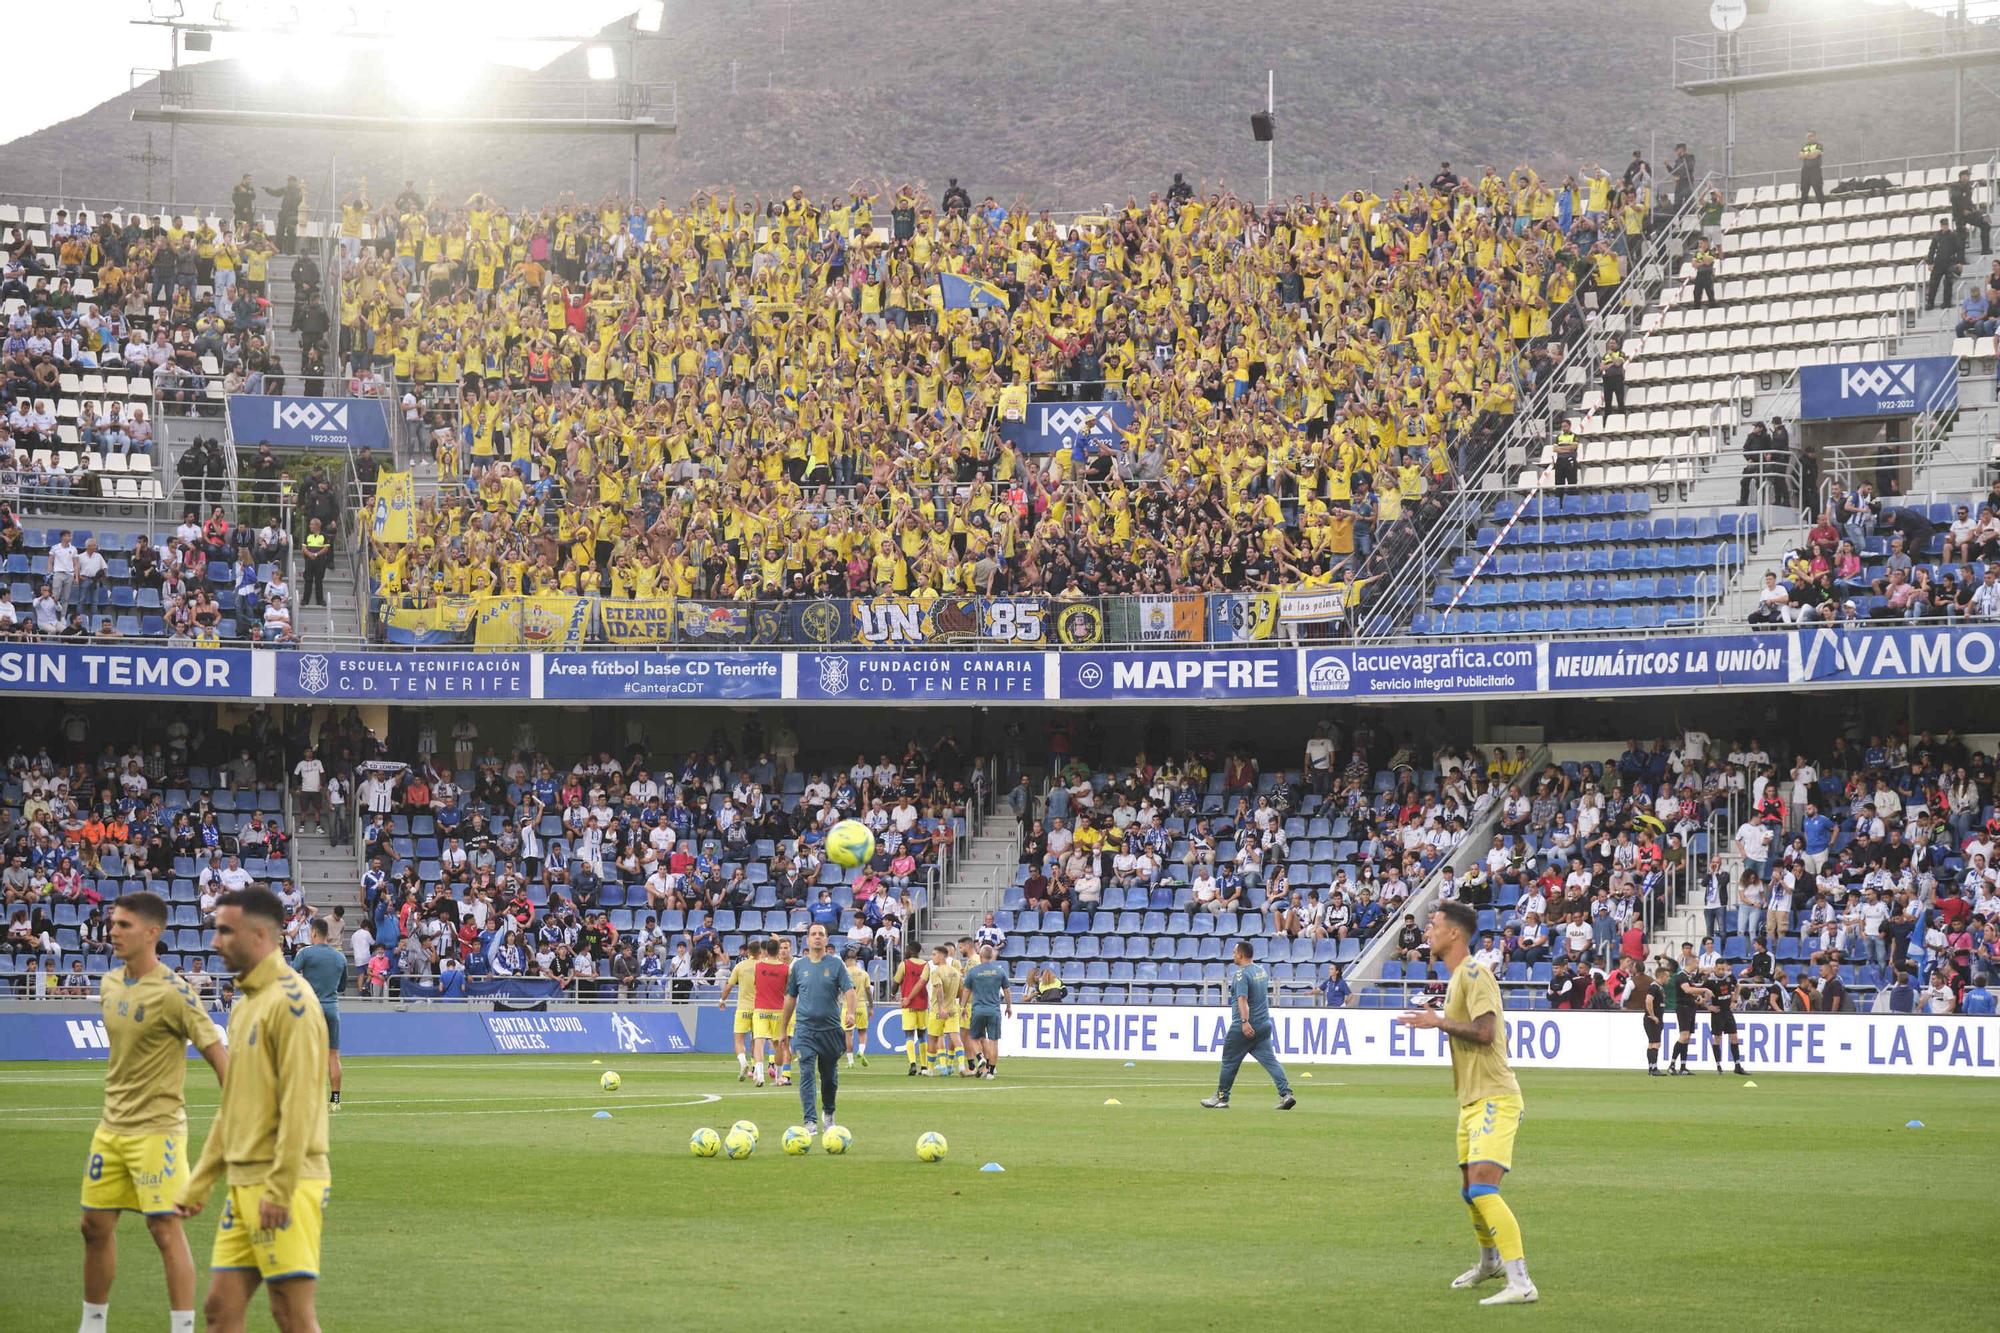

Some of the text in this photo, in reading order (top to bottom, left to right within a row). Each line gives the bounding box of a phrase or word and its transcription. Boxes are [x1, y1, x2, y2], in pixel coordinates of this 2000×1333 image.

[1878, 400, 1915, 410] 1922-2022
[310, 434, 347, 443] 1922-2022
[605, 607, 667, 621] ETERNO
[857, 604, 922, 641] UN
[992, 603, 1041, 641] 85
[1232, 601, 1257, 630] 85
[1164, 630, 1193, 640] ARMY
[1352, 647, 1532, 675] lacuevagrafica.com
[1555, 643, 1782, 677] NEUMÁTICOS LA UNIÓN
[1843, 631, 2000, 676] VAMO
[0, 652, 230, 688] SIN TEMOR
[340, 658, 520, 672] ESCUELA TECNIFICACIÓN
[549, 658, 777, 677] Área fútbol base CD Tenerife
[860, 658, 1032, 672] FUNDACIÓN CANARIA
[1113, 659, 1278, 689] MAPFRE
[1314, 668, 1345, 681] LCG
[1370, 674, 1515, 691] Servicio Integral Publicitario
[340, 677, 520, 691] C. D. TENERIFE
[623, 682, 705, 694] #CanteraCDT
[860, 677, 1032, 692] C. D. TENERIFE
[489, 1017, 534, 1033] CONTRA
[533, 1017, 550, 1032] LA
[1017, 1012, 1158, 1051] TENERIFE
[1869, 1025, 1913, 1066] LA
[1928, 1025, 2000, 1068] PAL
